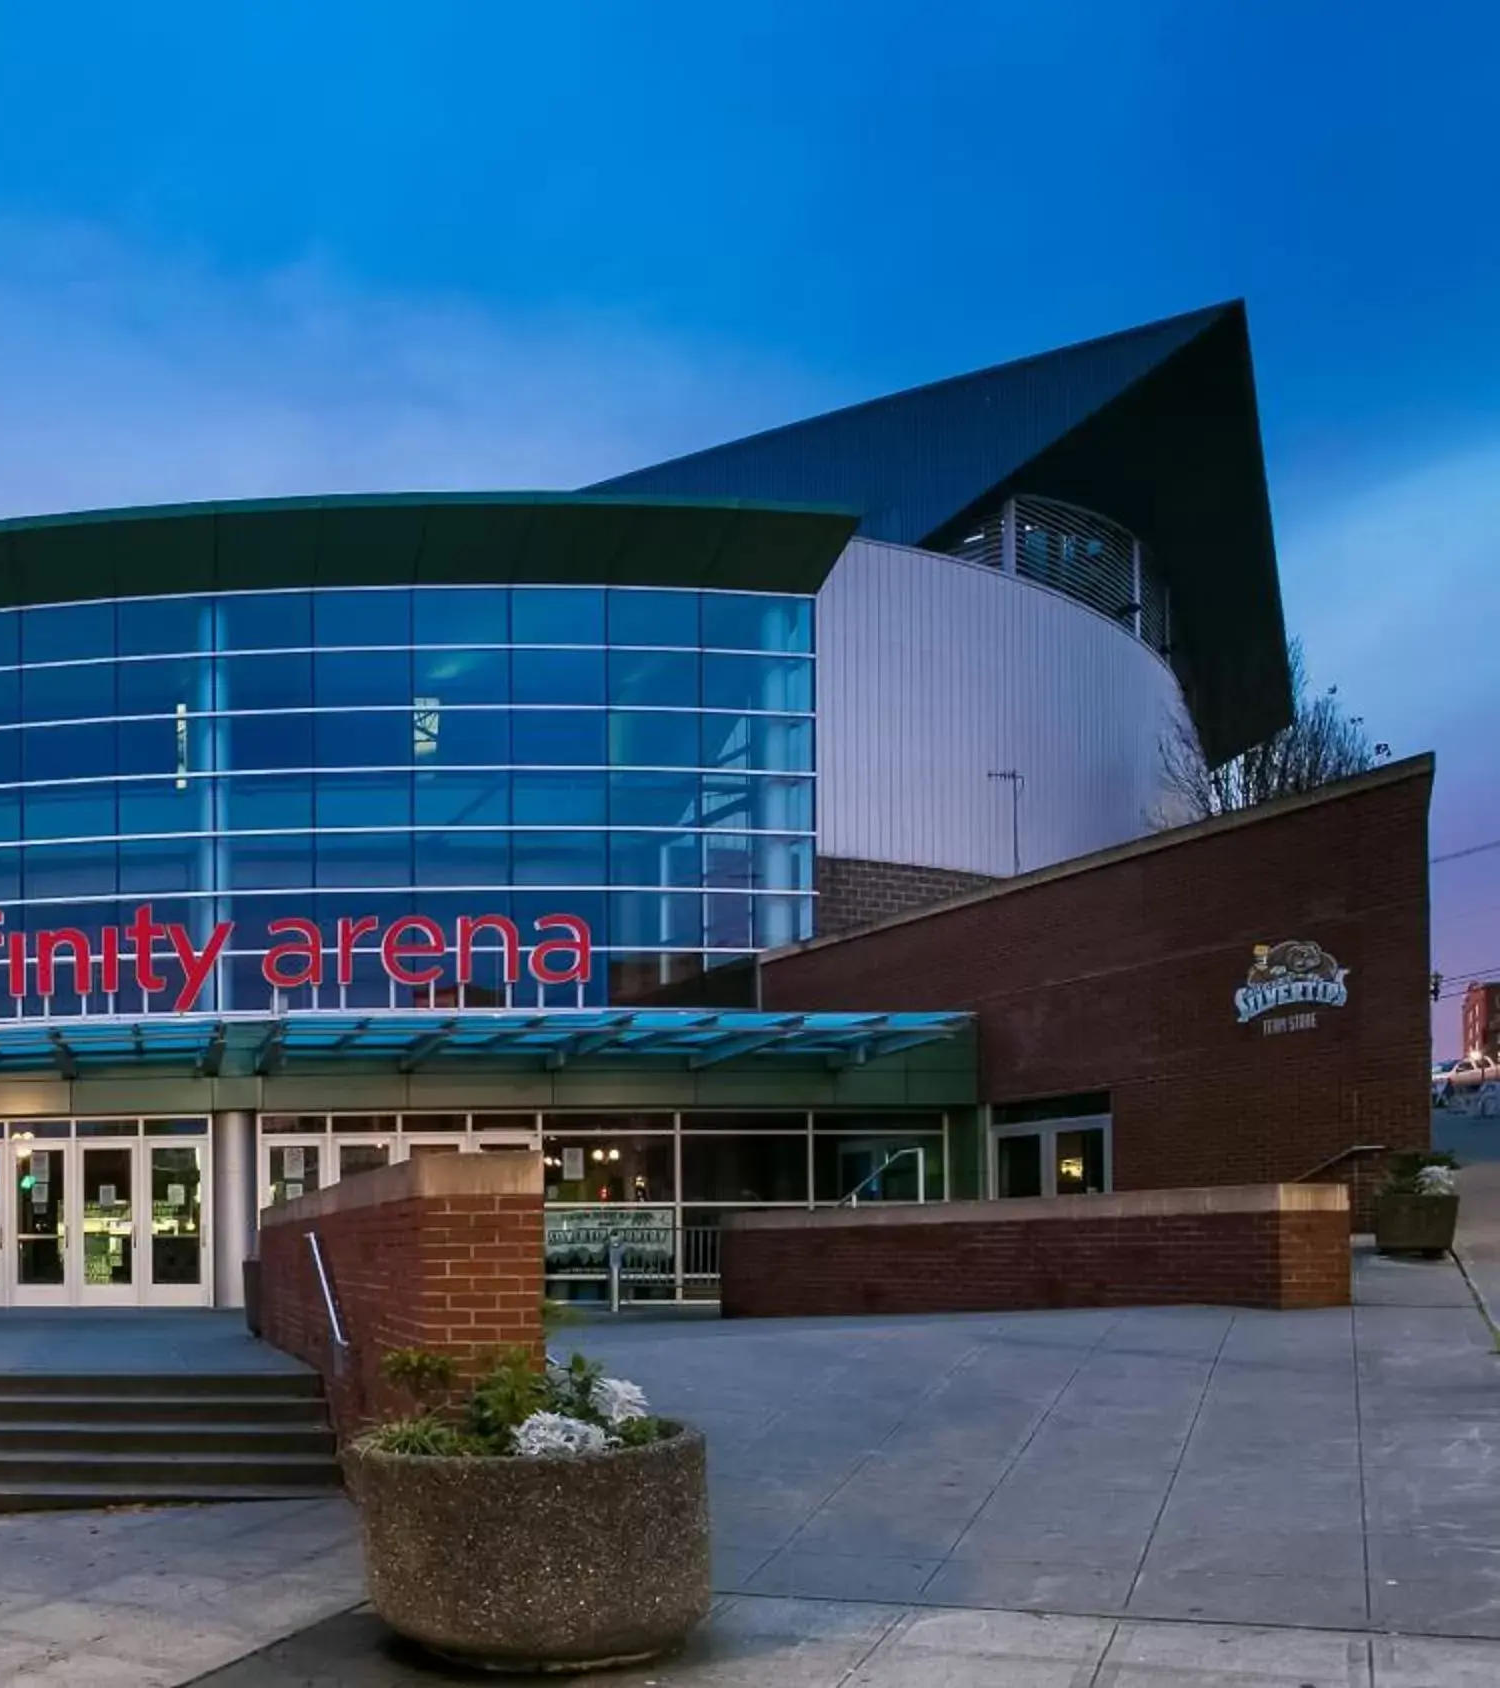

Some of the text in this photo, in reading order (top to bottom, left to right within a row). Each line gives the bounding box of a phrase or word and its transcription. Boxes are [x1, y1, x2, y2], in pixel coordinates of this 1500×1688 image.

[261, 913, 592, 988] arena
[1235, 969, 1349, 1022] SILVERTIPS
[1288, 1012, 1317, 1033] STORE
